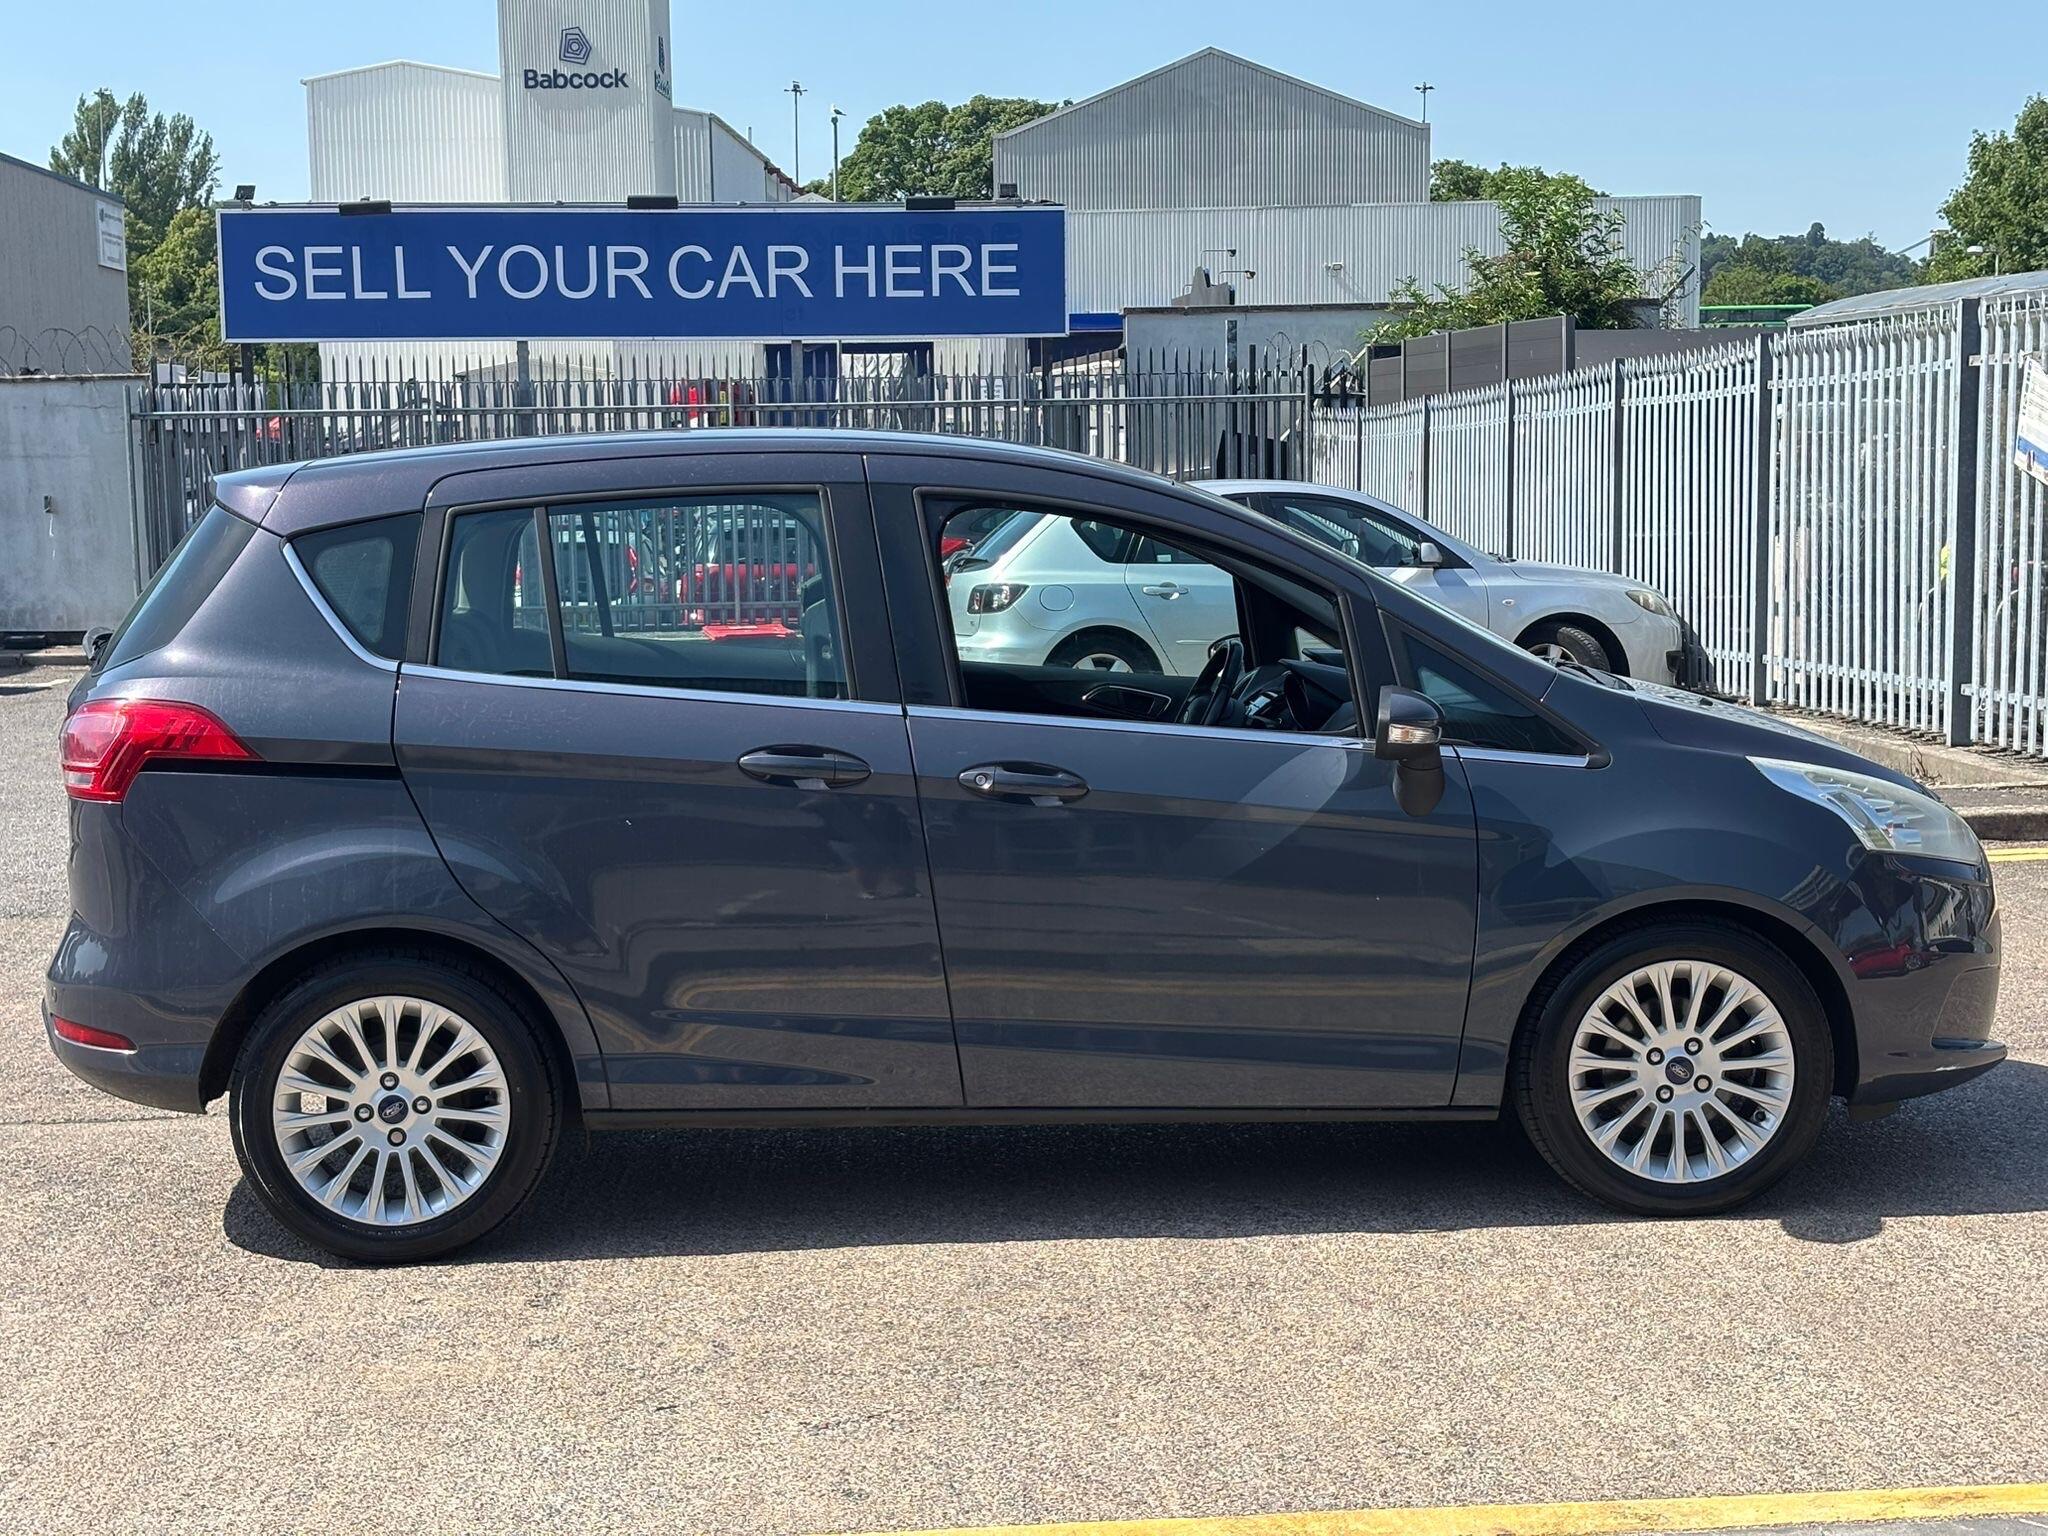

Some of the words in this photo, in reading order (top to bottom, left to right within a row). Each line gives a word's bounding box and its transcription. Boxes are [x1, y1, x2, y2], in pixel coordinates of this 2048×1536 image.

[523, 68, 629, 89] Babcock
[254, 245, 432, 301] SELL
[446, 244, 653, 300] YOUR
[668, 244, 814, 299] CAR
[835, 243, 1020, 298] HERE
